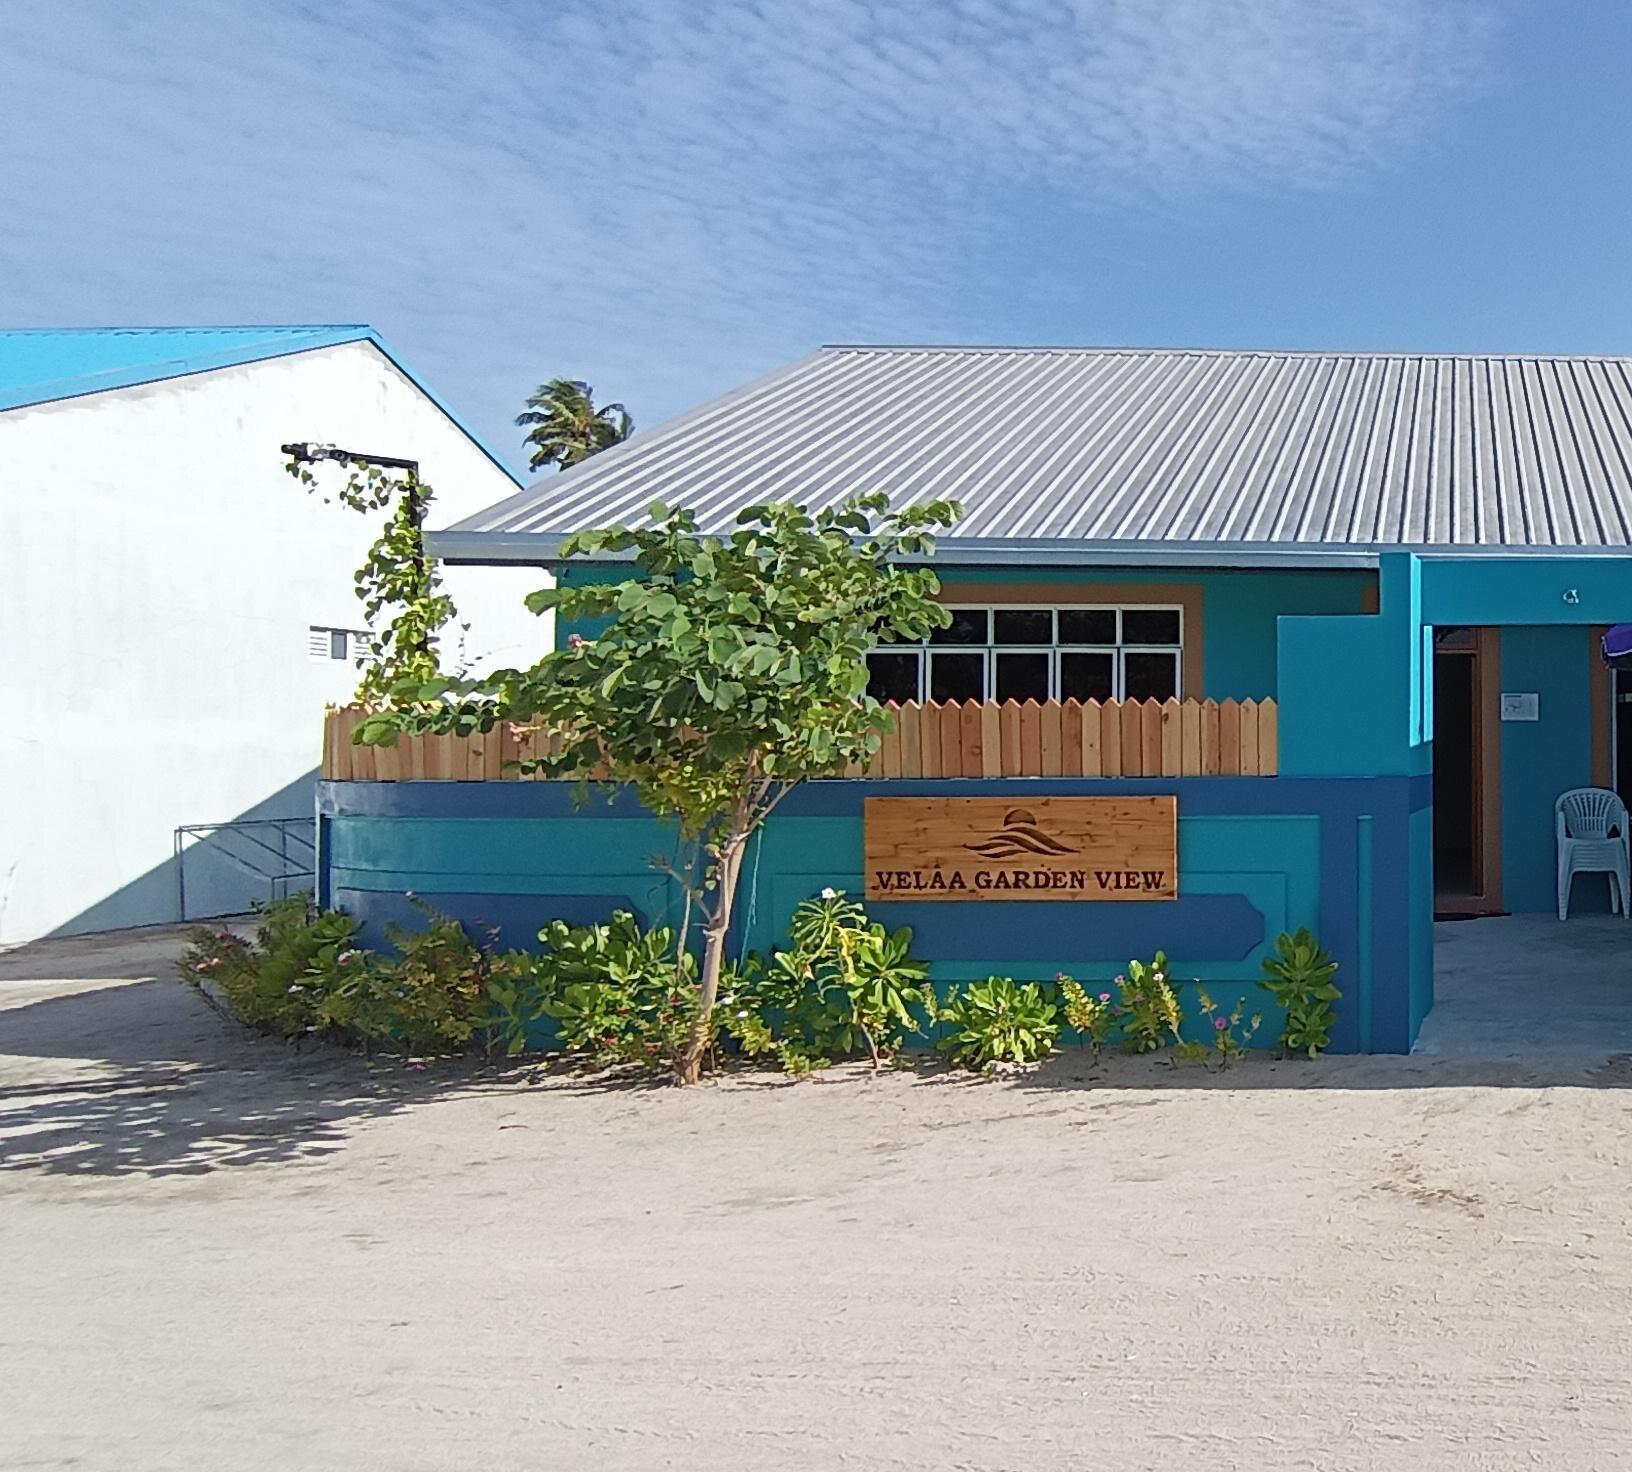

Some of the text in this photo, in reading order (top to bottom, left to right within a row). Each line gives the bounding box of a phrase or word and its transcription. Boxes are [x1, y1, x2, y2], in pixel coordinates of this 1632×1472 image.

[876, 870, 1165, 890] VELAA GARDEN VIEW
